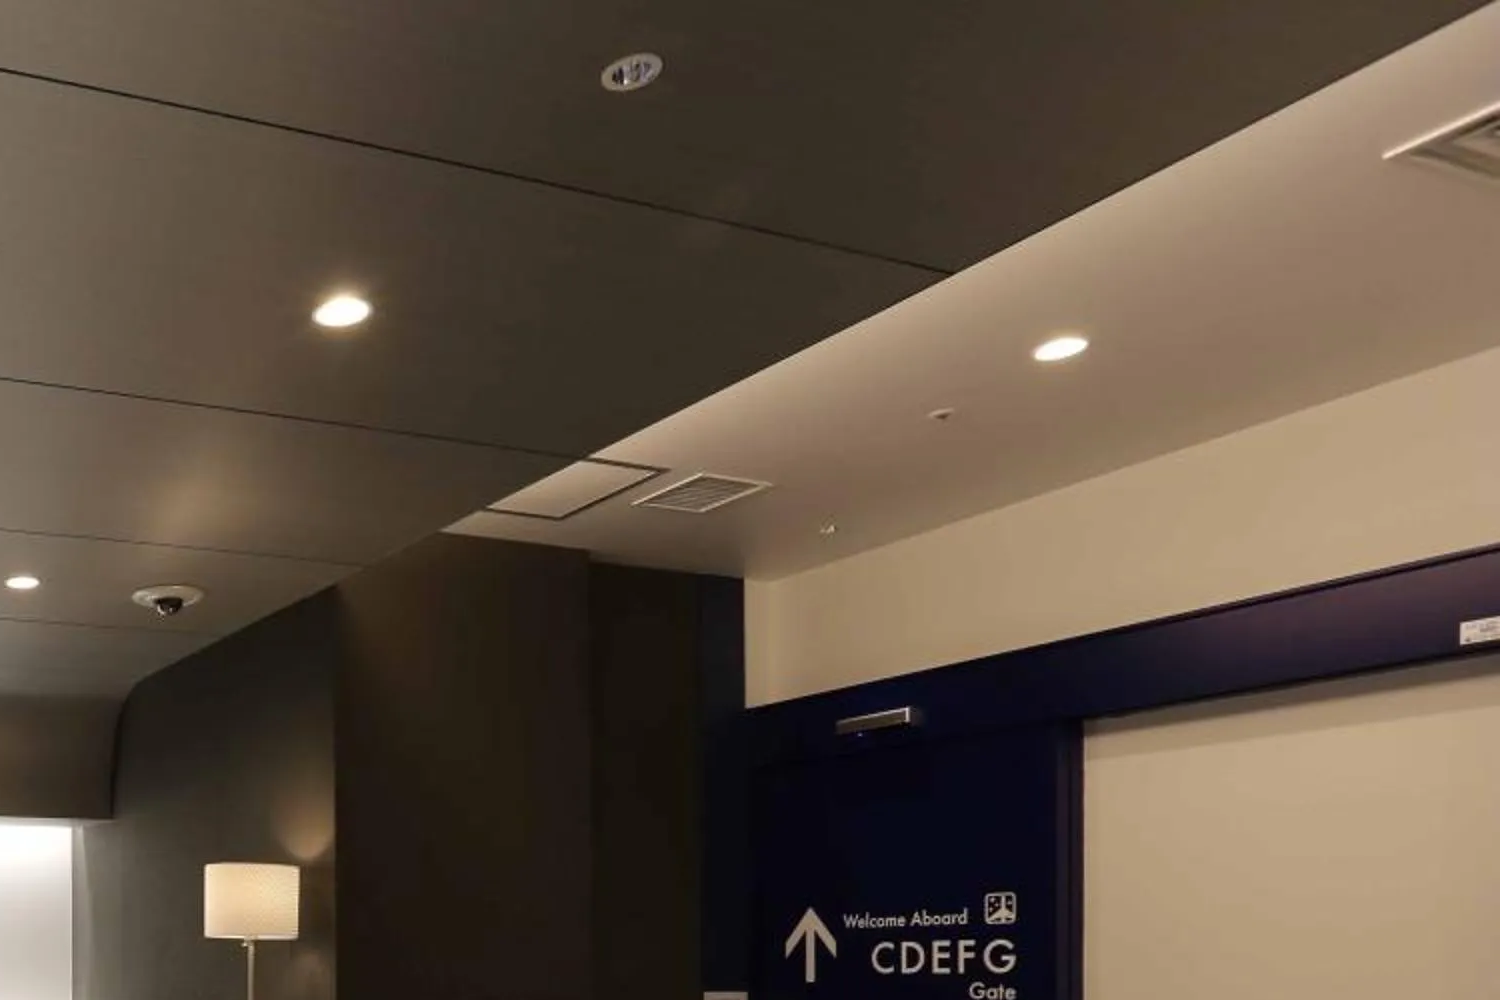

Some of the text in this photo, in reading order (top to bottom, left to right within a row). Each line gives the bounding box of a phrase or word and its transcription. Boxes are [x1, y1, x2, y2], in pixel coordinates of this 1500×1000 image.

[843, 908, 968, 928] Welcome Aboard
[872, 939, 1016, 974] CDEFG
[969, 982, 1016, 1000] Gate
